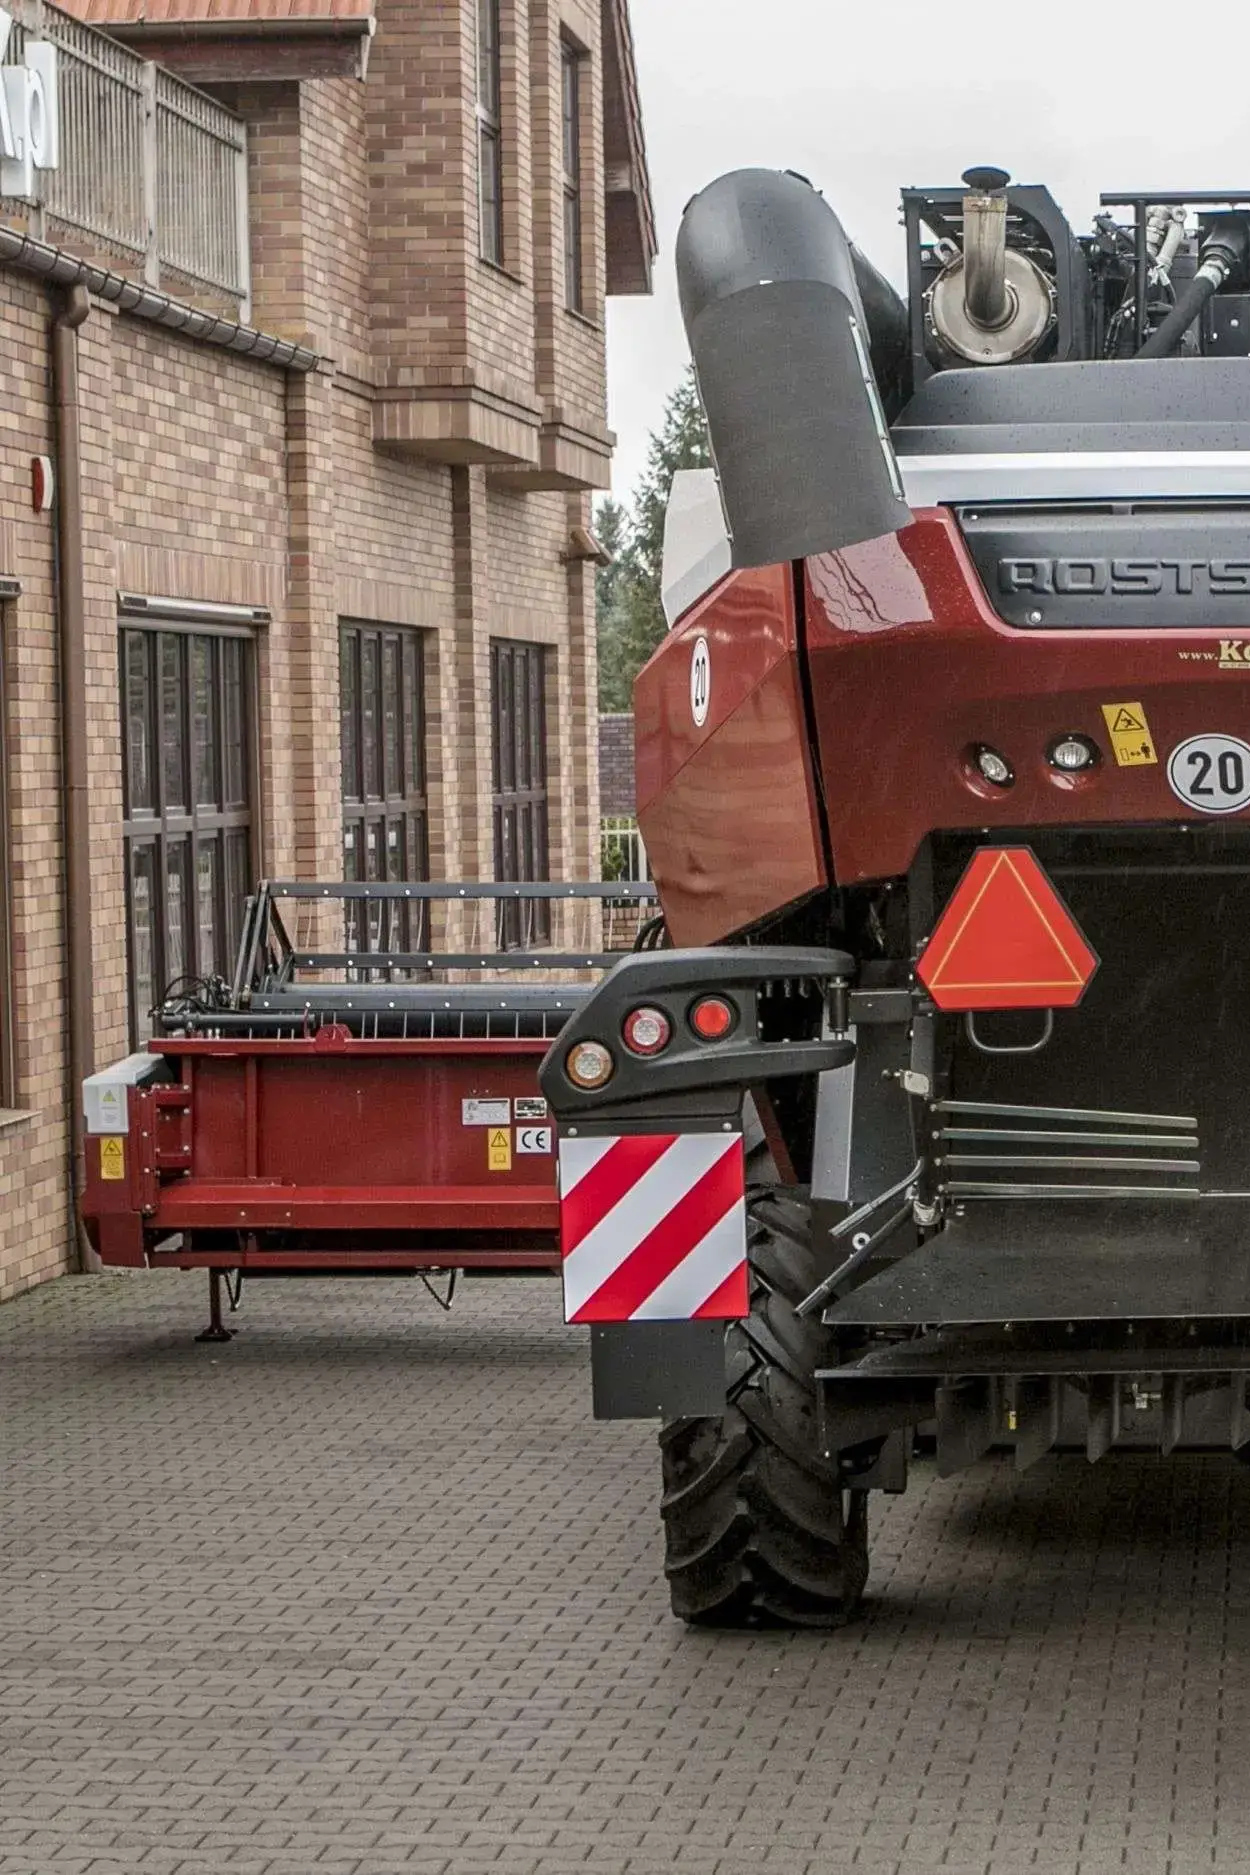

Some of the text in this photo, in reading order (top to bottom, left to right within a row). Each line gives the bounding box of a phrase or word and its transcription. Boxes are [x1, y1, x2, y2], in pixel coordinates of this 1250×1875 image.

[695, 656, 706, 707] 20
[1187, 751, 1244, 796] 20
[521, 1130, 545, 1149] CE
